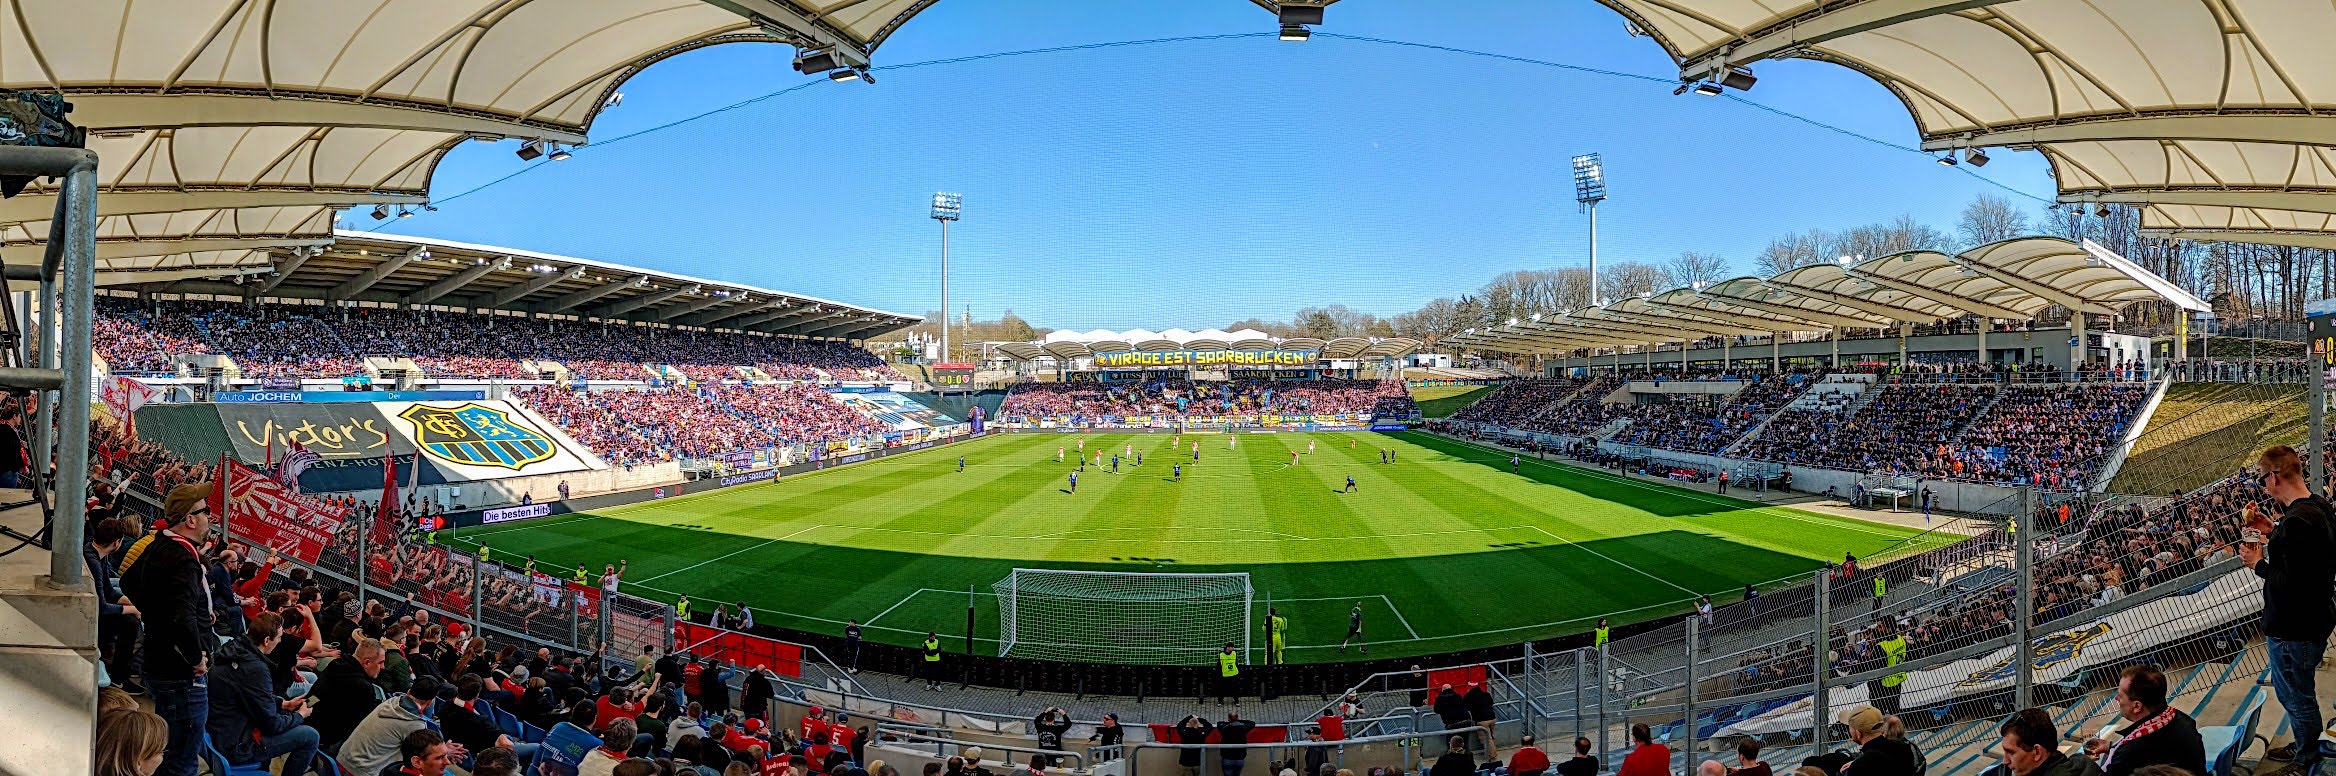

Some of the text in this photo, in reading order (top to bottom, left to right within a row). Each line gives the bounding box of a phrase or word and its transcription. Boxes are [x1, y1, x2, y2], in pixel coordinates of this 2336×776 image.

[1109, 352, 1161, 366] VIRAGE
[1164, 352, 1192, 364] EST
[219, 392, 302, 402] Auto JOCHEM
[388, 391, 401, 400] Der
[237, 417, 386, 449] Victor's
[484, 505, 551, 522] Die besten Hits
[804, 726, 812, 739] 7
[832, 731, 842, 745] 5
